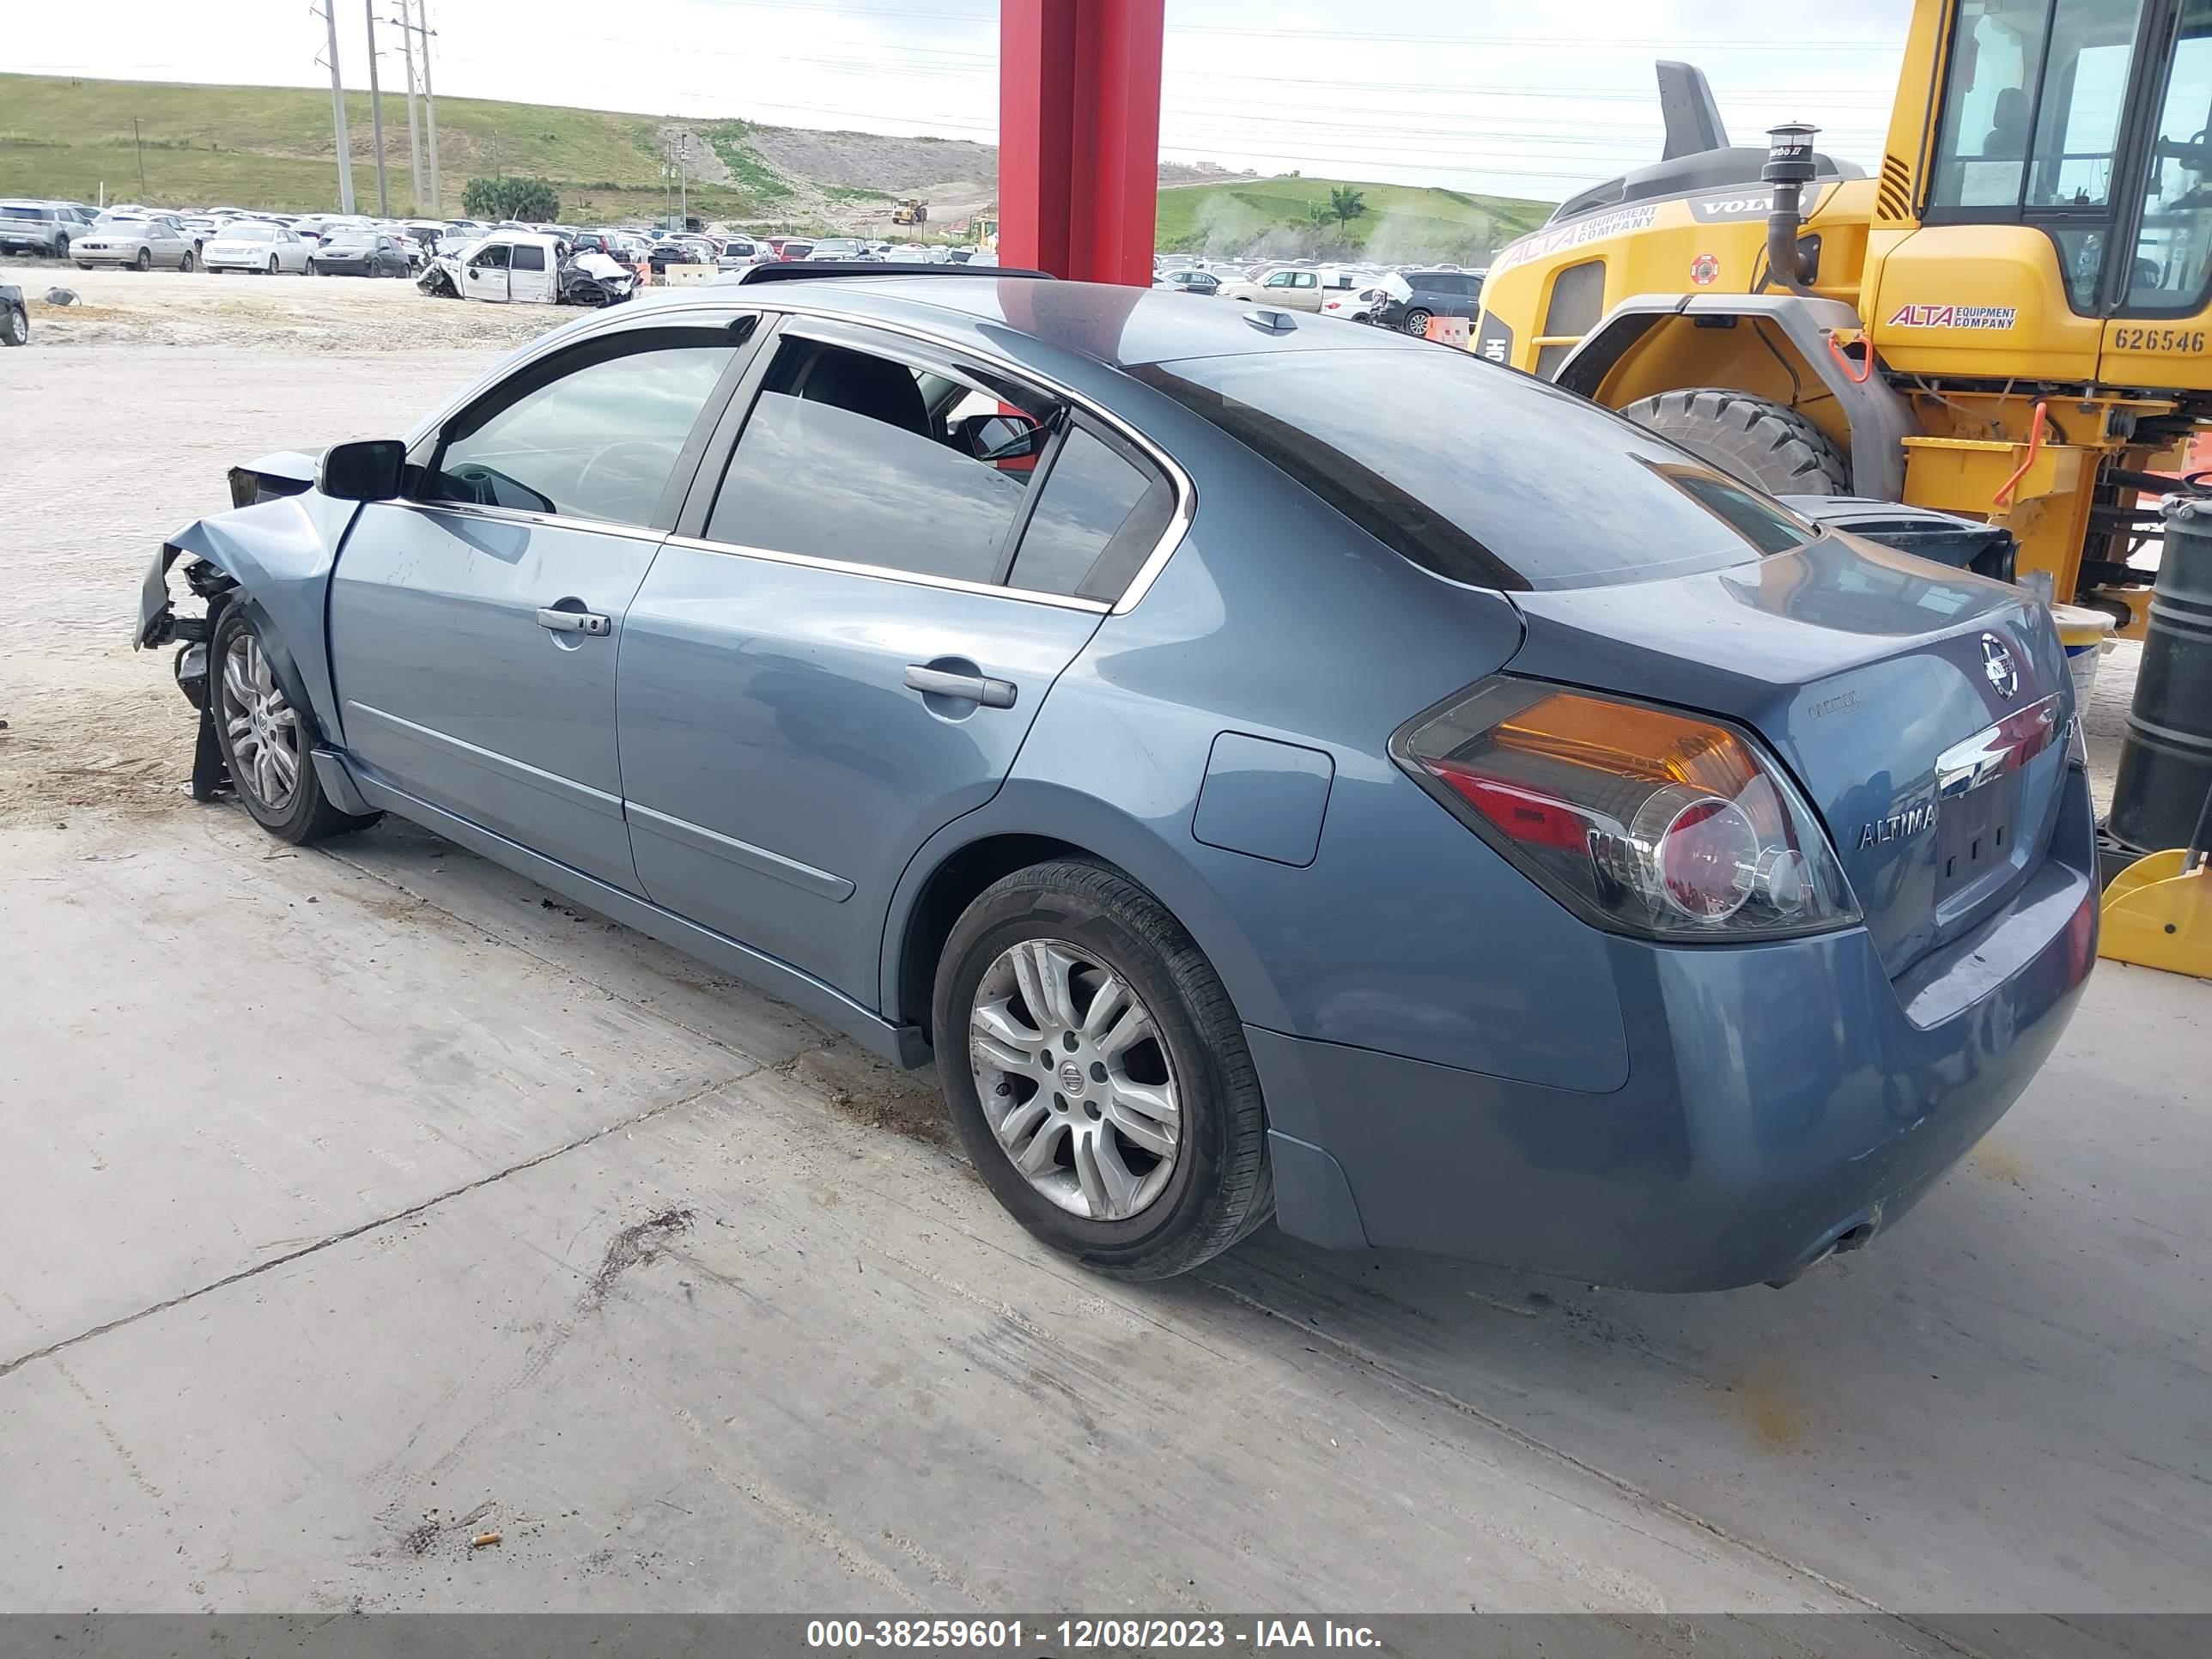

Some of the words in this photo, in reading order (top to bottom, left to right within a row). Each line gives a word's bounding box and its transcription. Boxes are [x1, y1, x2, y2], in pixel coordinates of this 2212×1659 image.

[1577, 216, 1656, 243] COMPANY
[1580, 206, 1659, 232] EQUIPMENT
[1501, 224, 1577, 271] ALTA
[1887, 304, 1955, 327] ALTA
[1954, 318, 2014, 329] COMPANY
[1956, 307, 2017, 319] EQUIPMENT
[2115, 328, 2205, 353] 626546
[1857, 804, 1936, 850] ALTIMA
